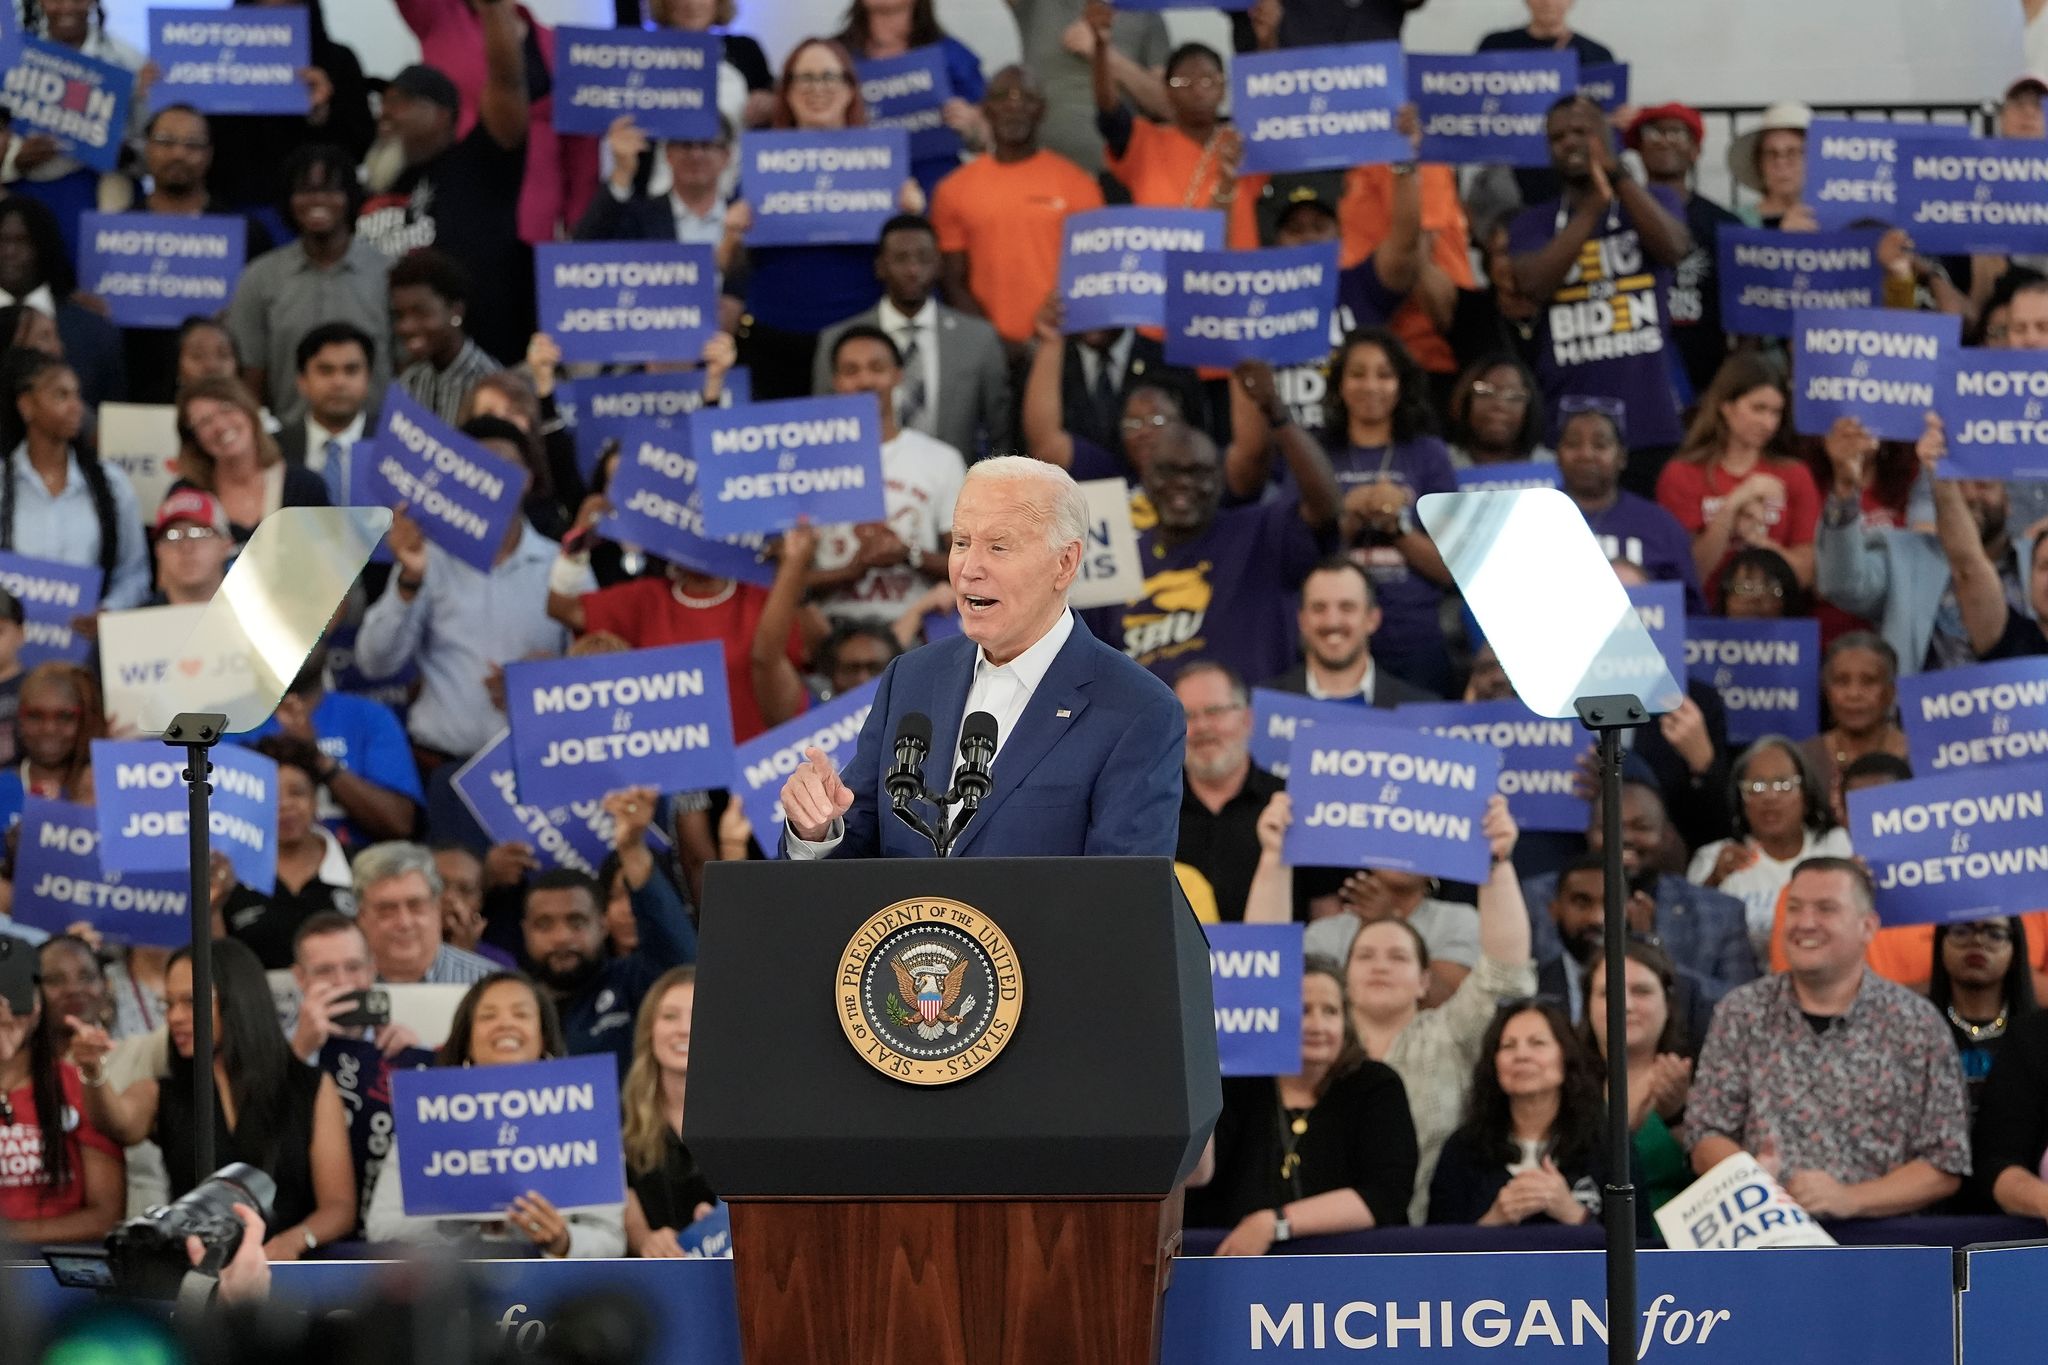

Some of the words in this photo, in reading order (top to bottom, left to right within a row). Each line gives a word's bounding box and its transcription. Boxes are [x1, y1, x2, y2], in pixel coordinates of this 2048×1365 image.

[161, 23, 292, 47] MOTOWN
[164, 62, 294, 85] JOETOWN
[569, 43, 704, 71] MOTOWN
[862, 68, 933, 103] OWN
[1247, 64, 1387, 98] MOTOWN
[1421, 69, 1560, 96] MOTOWN
[571, 86, 703, 110] JOETOWN
[1251, 109, 1391, 142] JOETOWN
[1424, 113, 1547, 136] JOETOW
[757, 147, 892, 172] MOTOWN
[1821, 137, 1897, 162] MOTO
[760, 190, 893, 214] JOETOWN
[1818, 180, 1897, 204] JOETO
[96, 230, 229, 259] MOTOWN
[1070, 226, 1205, 254] MOTOWN
[1735, 244, 1870, 271] MOTOWN
[97, 274, 227, 299] JOETOWN
[554, 262, 699, 289] MOTOWN
[1068, 271, 1168, 299] JOETOW
[1183, 262, 1323, 296] MOTOWN
[558, 306, 701, 332] JOETOWN
[1184, 307, 1320, 340] JOETOWN
[1551, 289, 1659, 341] BIDEN
[1553, 325, 1664, 367] HARRIS
[1805, 328, 1939, 361] MOTOWN
[1806, 376, 1934, 407] JOETOWN
[1956, 371, 2048, 397] MOTO
[711, 416, 861, 456] MOTOWN
[1956, 419, 2048, 445] JOETO
[389, 411, 504, 501] MOTOWN
[637, 441, 698, 485] MOT
[378, 455, 490, 540] JOETOWN
[718, 465, 865, 502] JOETOWN
[1683, 639, 1800, 665] OTOWN
[533, 668, 704, 715] MOTOWN
[1920, 677, 2048, 722] MOTOW
[612, 707, 633, 733] is
[1421, 721, 1574, 748] TOWN
[541, 723, 711, 767] JOETOWN
[1931, 729, 2048, 769] JOETOW
[1309, 749, 1477, 791] MOTOWN
[1304, 802, 1472, 841] JOETOWN
[1871, 790, 2044, 838] MOTOWN
[121, 810, 265, 853] JOEOWN
[1951, 830, 1971, 853] is
[1880, 845, 2048, 889] JOETOWN
[33, 873, 188, 916] JOETOWN
[929, 905, 947, 919] OF
[950, 907, 974, 928] THE
[842, 903, 925, 988] PRESIDENT
[977, 925, 1018, 1002] UNITED
[844, 993, 861, 1021] THE
[852, 1020, 867, 1040] OF
[945, 1017, 1010, 1076] STATES
[866, 1034, 914, 1077] SEAL
[416, 1082, 594, 1123] MOTOWN
[496, 1121, 519, 1147] is
[423, 1139, 598, 1177] JOETOWN
[1681, 1166, 1762, 1224] MICHIG
[1690, 1184, 1770, 1249] BID
[495, 1303, 548, 1353] fo
[1249, 1298, 1609, 1350] MICHIGAN
[1637, 1293, 1731, 1362] for
